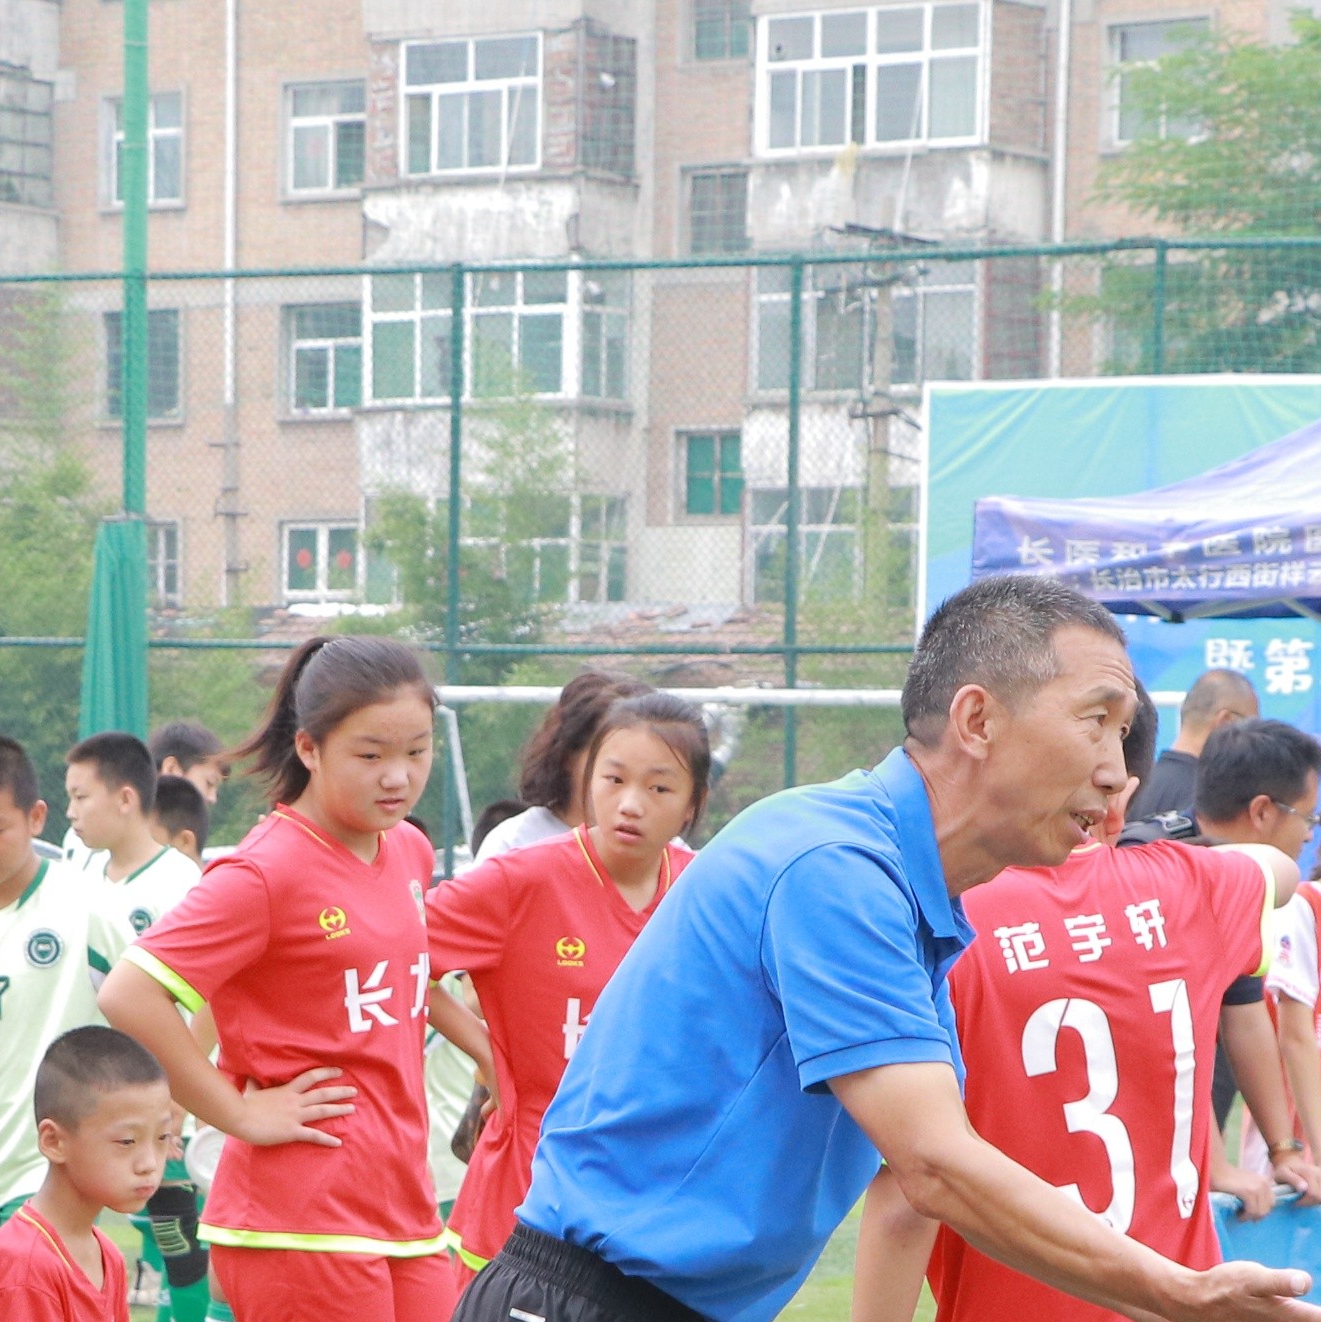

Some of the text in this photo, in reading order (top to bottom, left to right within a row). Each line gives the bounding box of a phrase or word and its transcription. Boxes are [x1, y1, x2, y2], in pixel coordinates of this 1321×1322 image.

[994, 899, 1167, 974] 范宇轩
[1021, 978, 1199, 1235] 31
